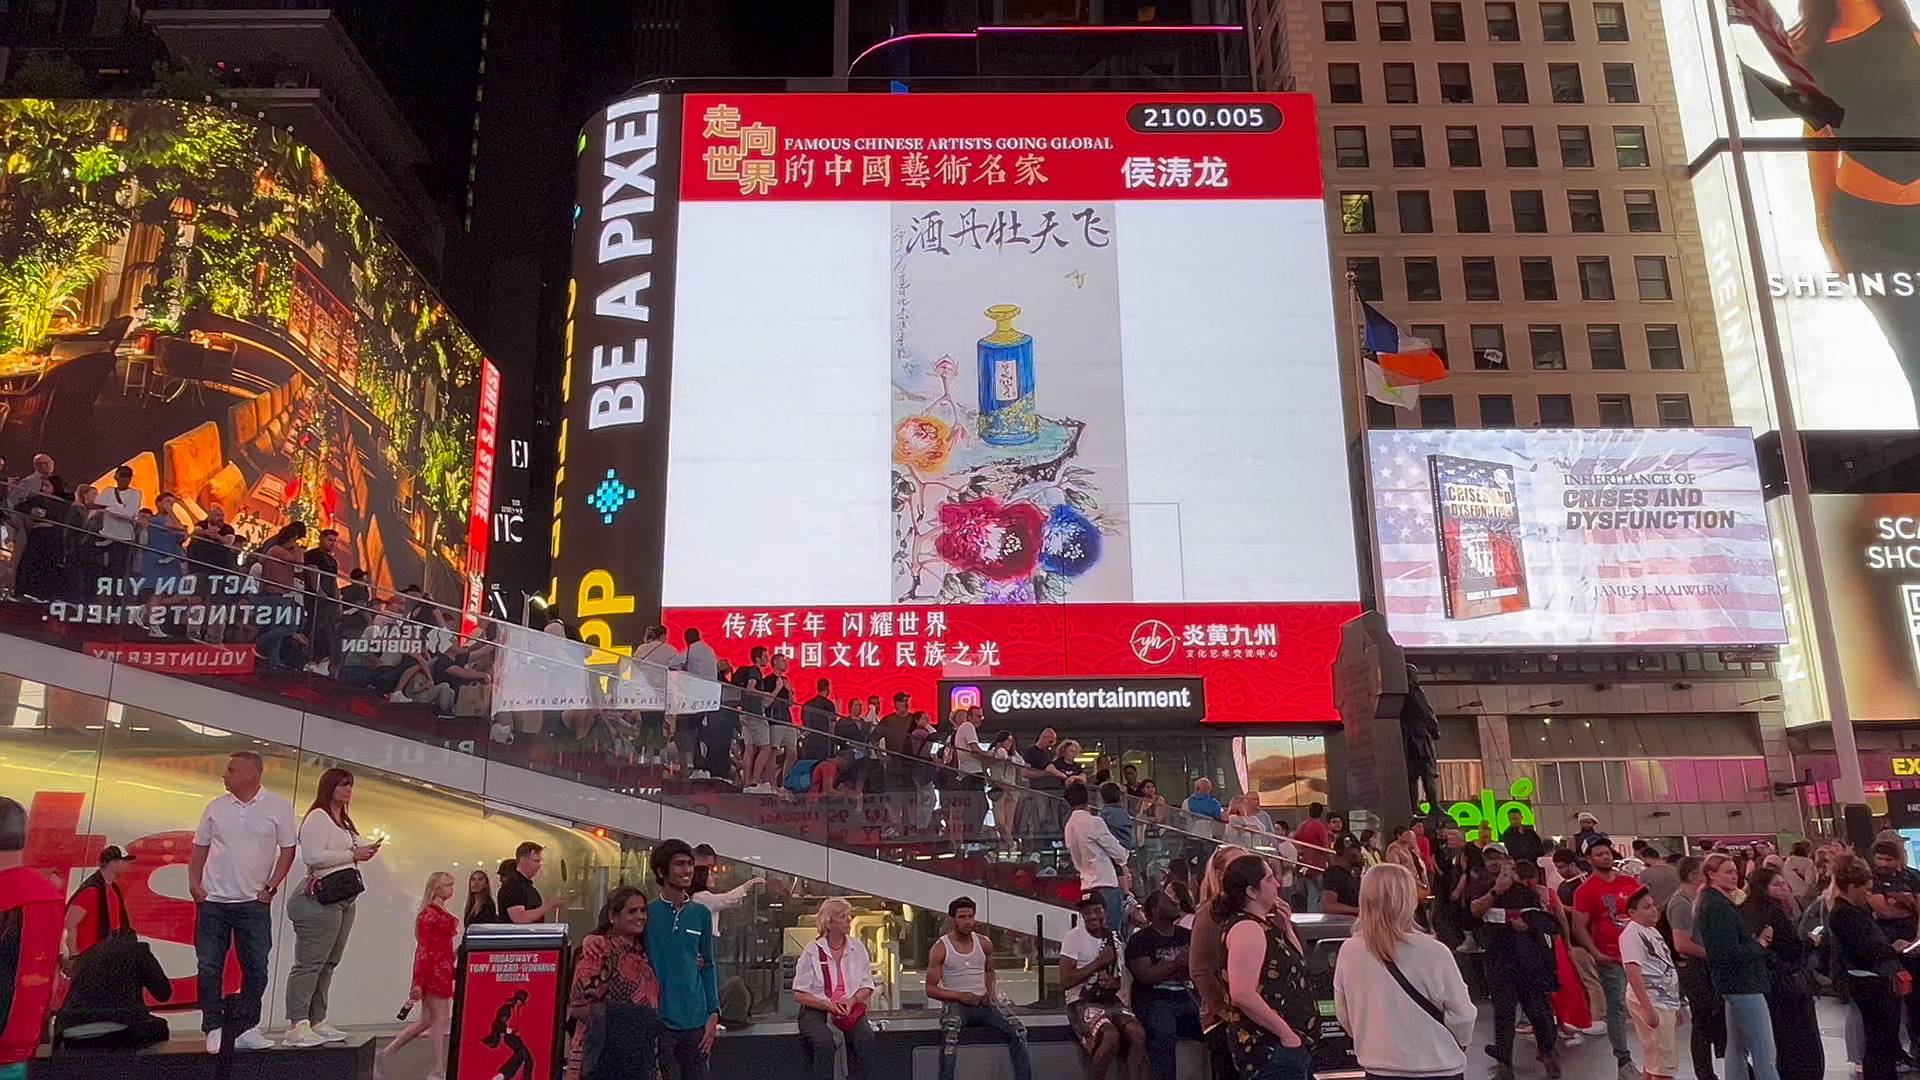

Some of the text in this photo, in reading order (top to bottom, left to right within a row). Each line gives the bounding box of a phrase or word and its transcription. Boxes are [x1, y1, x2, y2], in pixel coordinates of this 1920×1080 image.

[1144, 108, 1264, 127] 2100.005
[784, 137, 1113, 150] FAMOUS CHINESE ARTISTS GOING GLOBAL
[1121, 156, 1228, 188] 侯涛龙
[1768, 273, 1887, 297] SHEIN
[595, 271, 651, 322] A
[588, 338, 648, 430] BE
[475, 450, 494, 522] STORE
[1564, 474, 1696, 486] INHERITANCE OF
[1563, 488, 1703, 508] CRISES AND
[1566, 511, 1736, 530] DYSFUNCTION
[1594, 585, 1639, 598] JAMES
[722, 611, 948, 639] 传承千年 闪耀世界
[1182, 624, 1277, 647] 炎黄九州
[774, 640, 1000, 668] 中国文化 民族之光
[991, 687, 1191, 713] @tsxentertainment
[469, 963, 556, 973] TONY AWARD-WINNING
[489, 953, 539, 963] BROADWAY'S
[495, 973, 530, 982] MUSICAL
